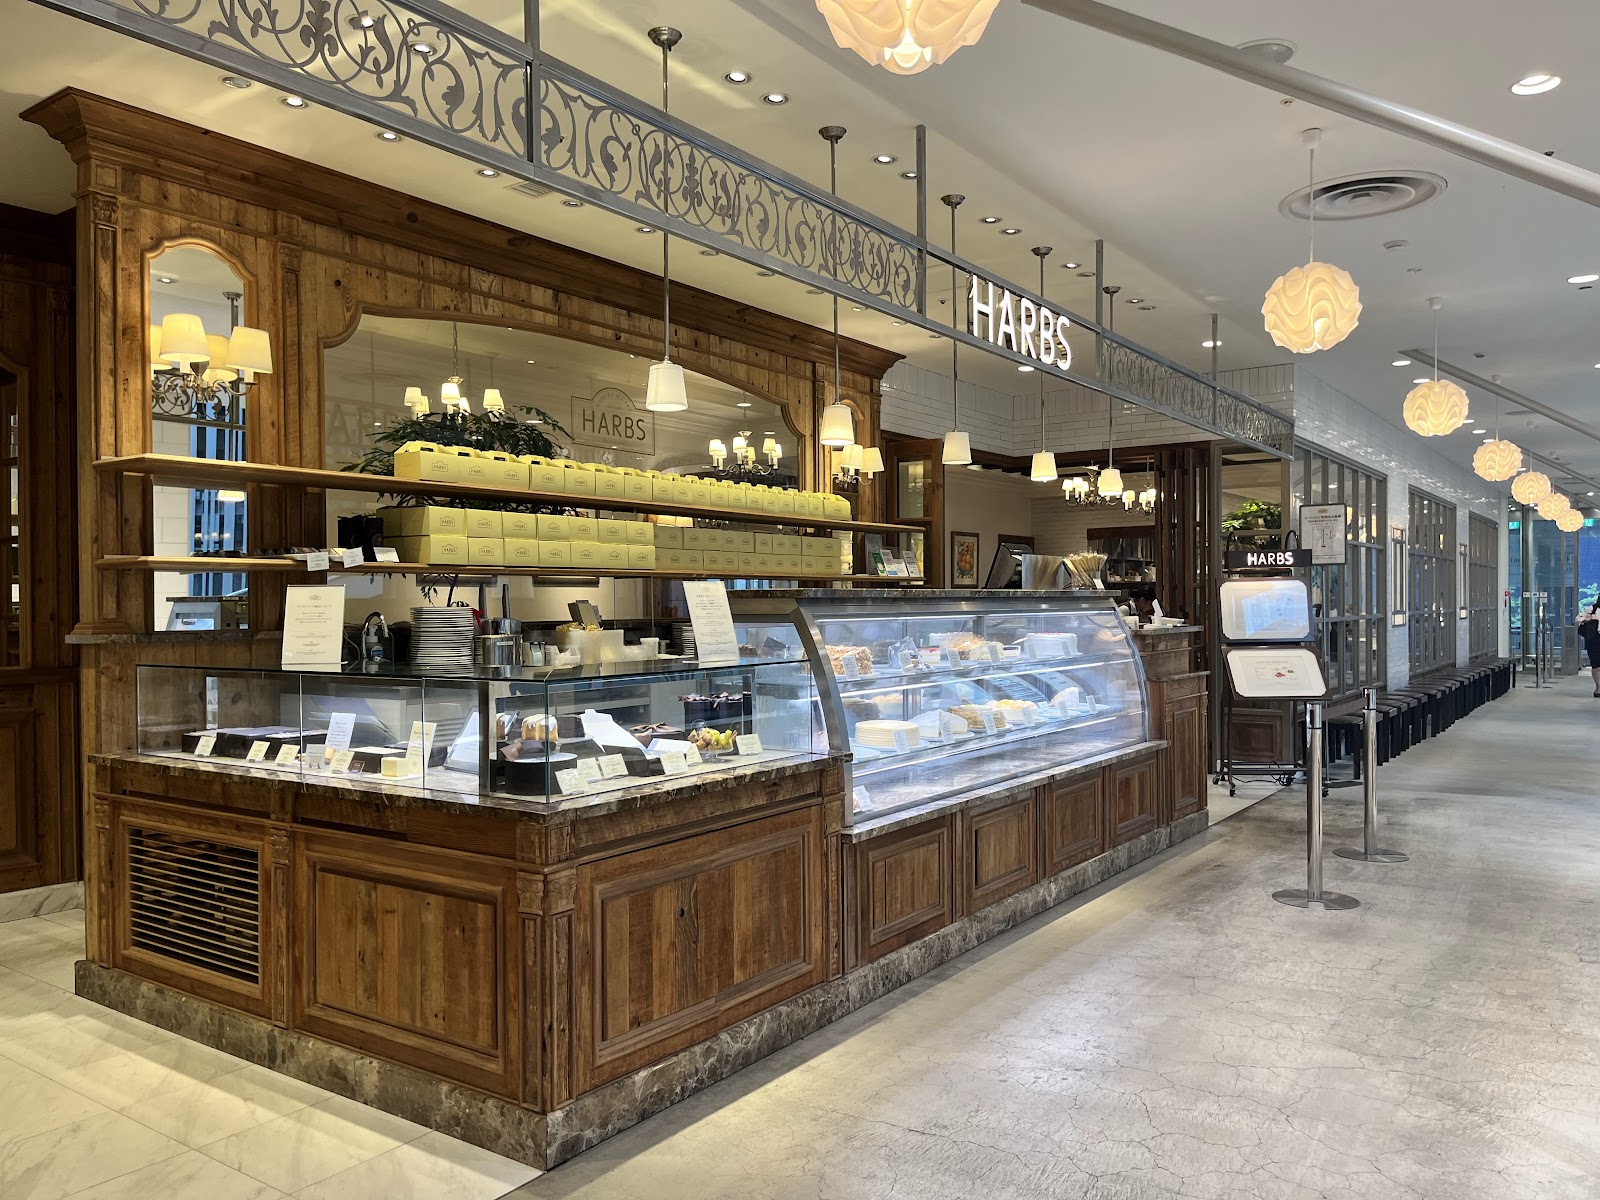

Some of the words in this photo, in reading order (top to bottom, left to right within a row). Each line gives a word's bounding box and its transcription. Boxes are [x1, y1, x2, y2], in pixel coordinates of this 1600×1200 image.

[972, 274, 1072, 372] HARBS
[582, 408, 646, 441] HARBS
[1247, 551, 1294, 566] HARBS
